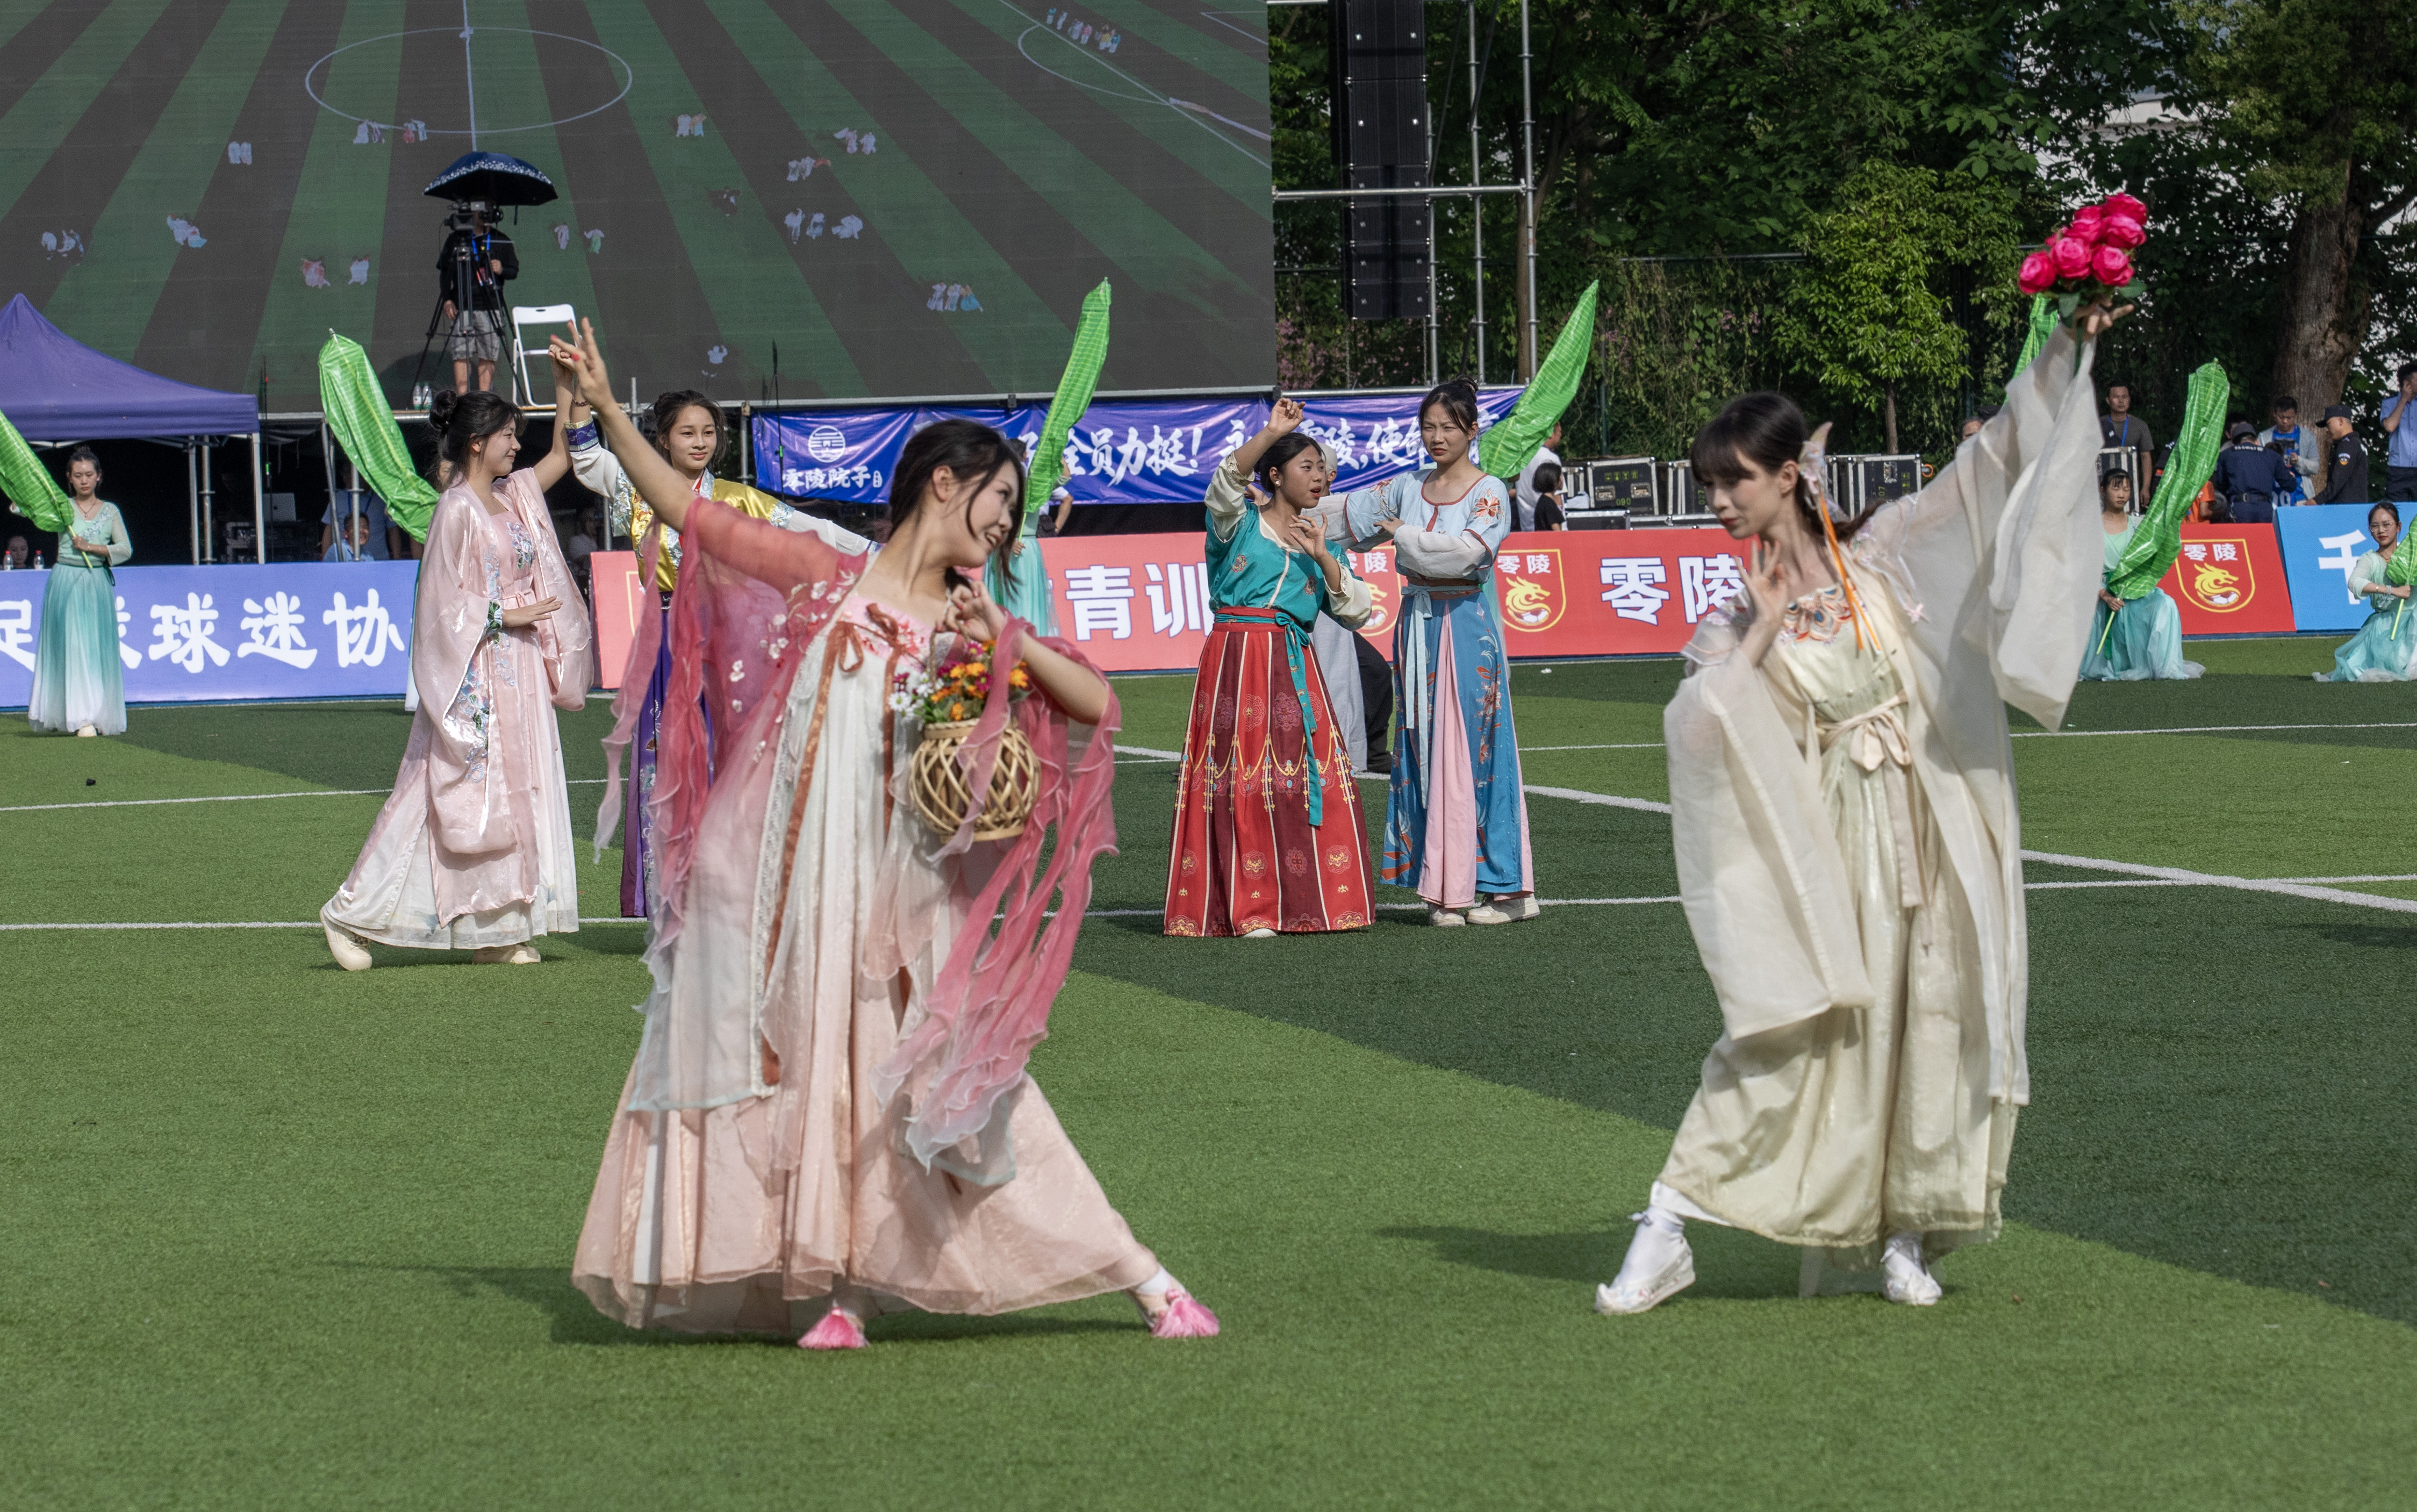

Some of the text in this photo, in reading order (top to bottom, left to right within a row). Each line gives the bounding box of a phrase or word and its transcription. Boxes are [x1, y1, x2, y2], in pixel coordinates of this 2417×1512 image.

[782, 465, 871, 491] 零陵院子
[1497, 554, 1551, 575] 零陵
[2184, 543, 2238, 561] 零陵
[1048, 563, 1208, 641] 青训
[0, 589, 413, 673] 足球迷协
